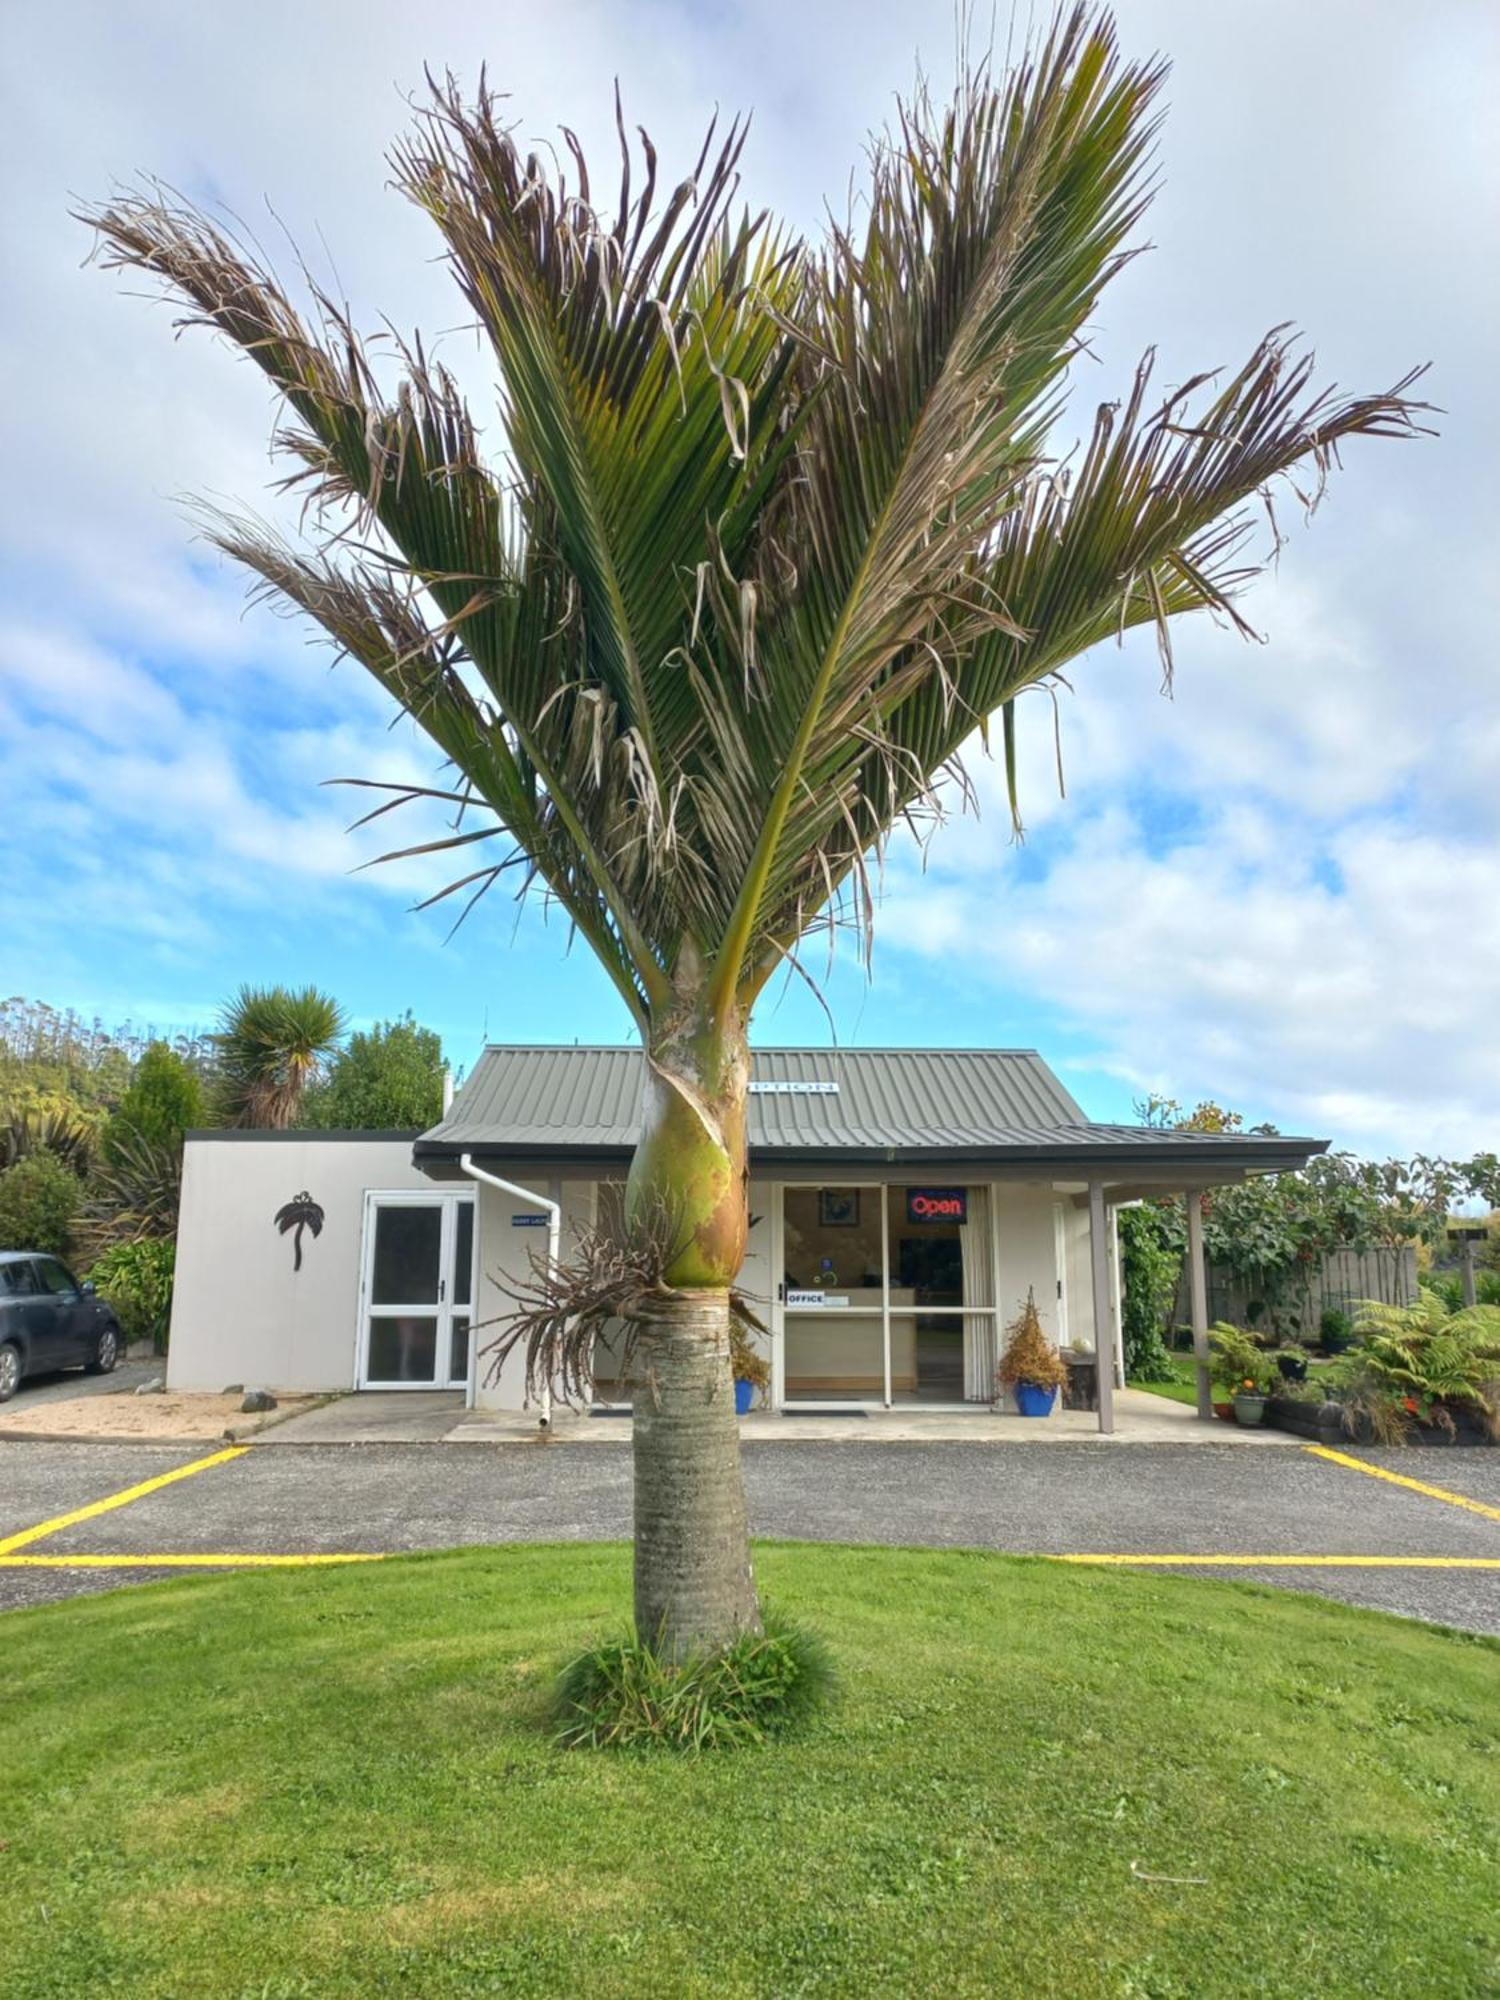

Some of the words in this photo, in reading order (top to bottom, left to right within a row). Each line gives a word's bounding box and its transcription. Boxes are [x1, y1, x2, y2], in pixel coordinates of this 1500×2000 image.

[753, 1083, 834, 1091] PTION
[911, 1196, 961, 1217] Open
[788, 1294, 824, 1304] OFFICE
